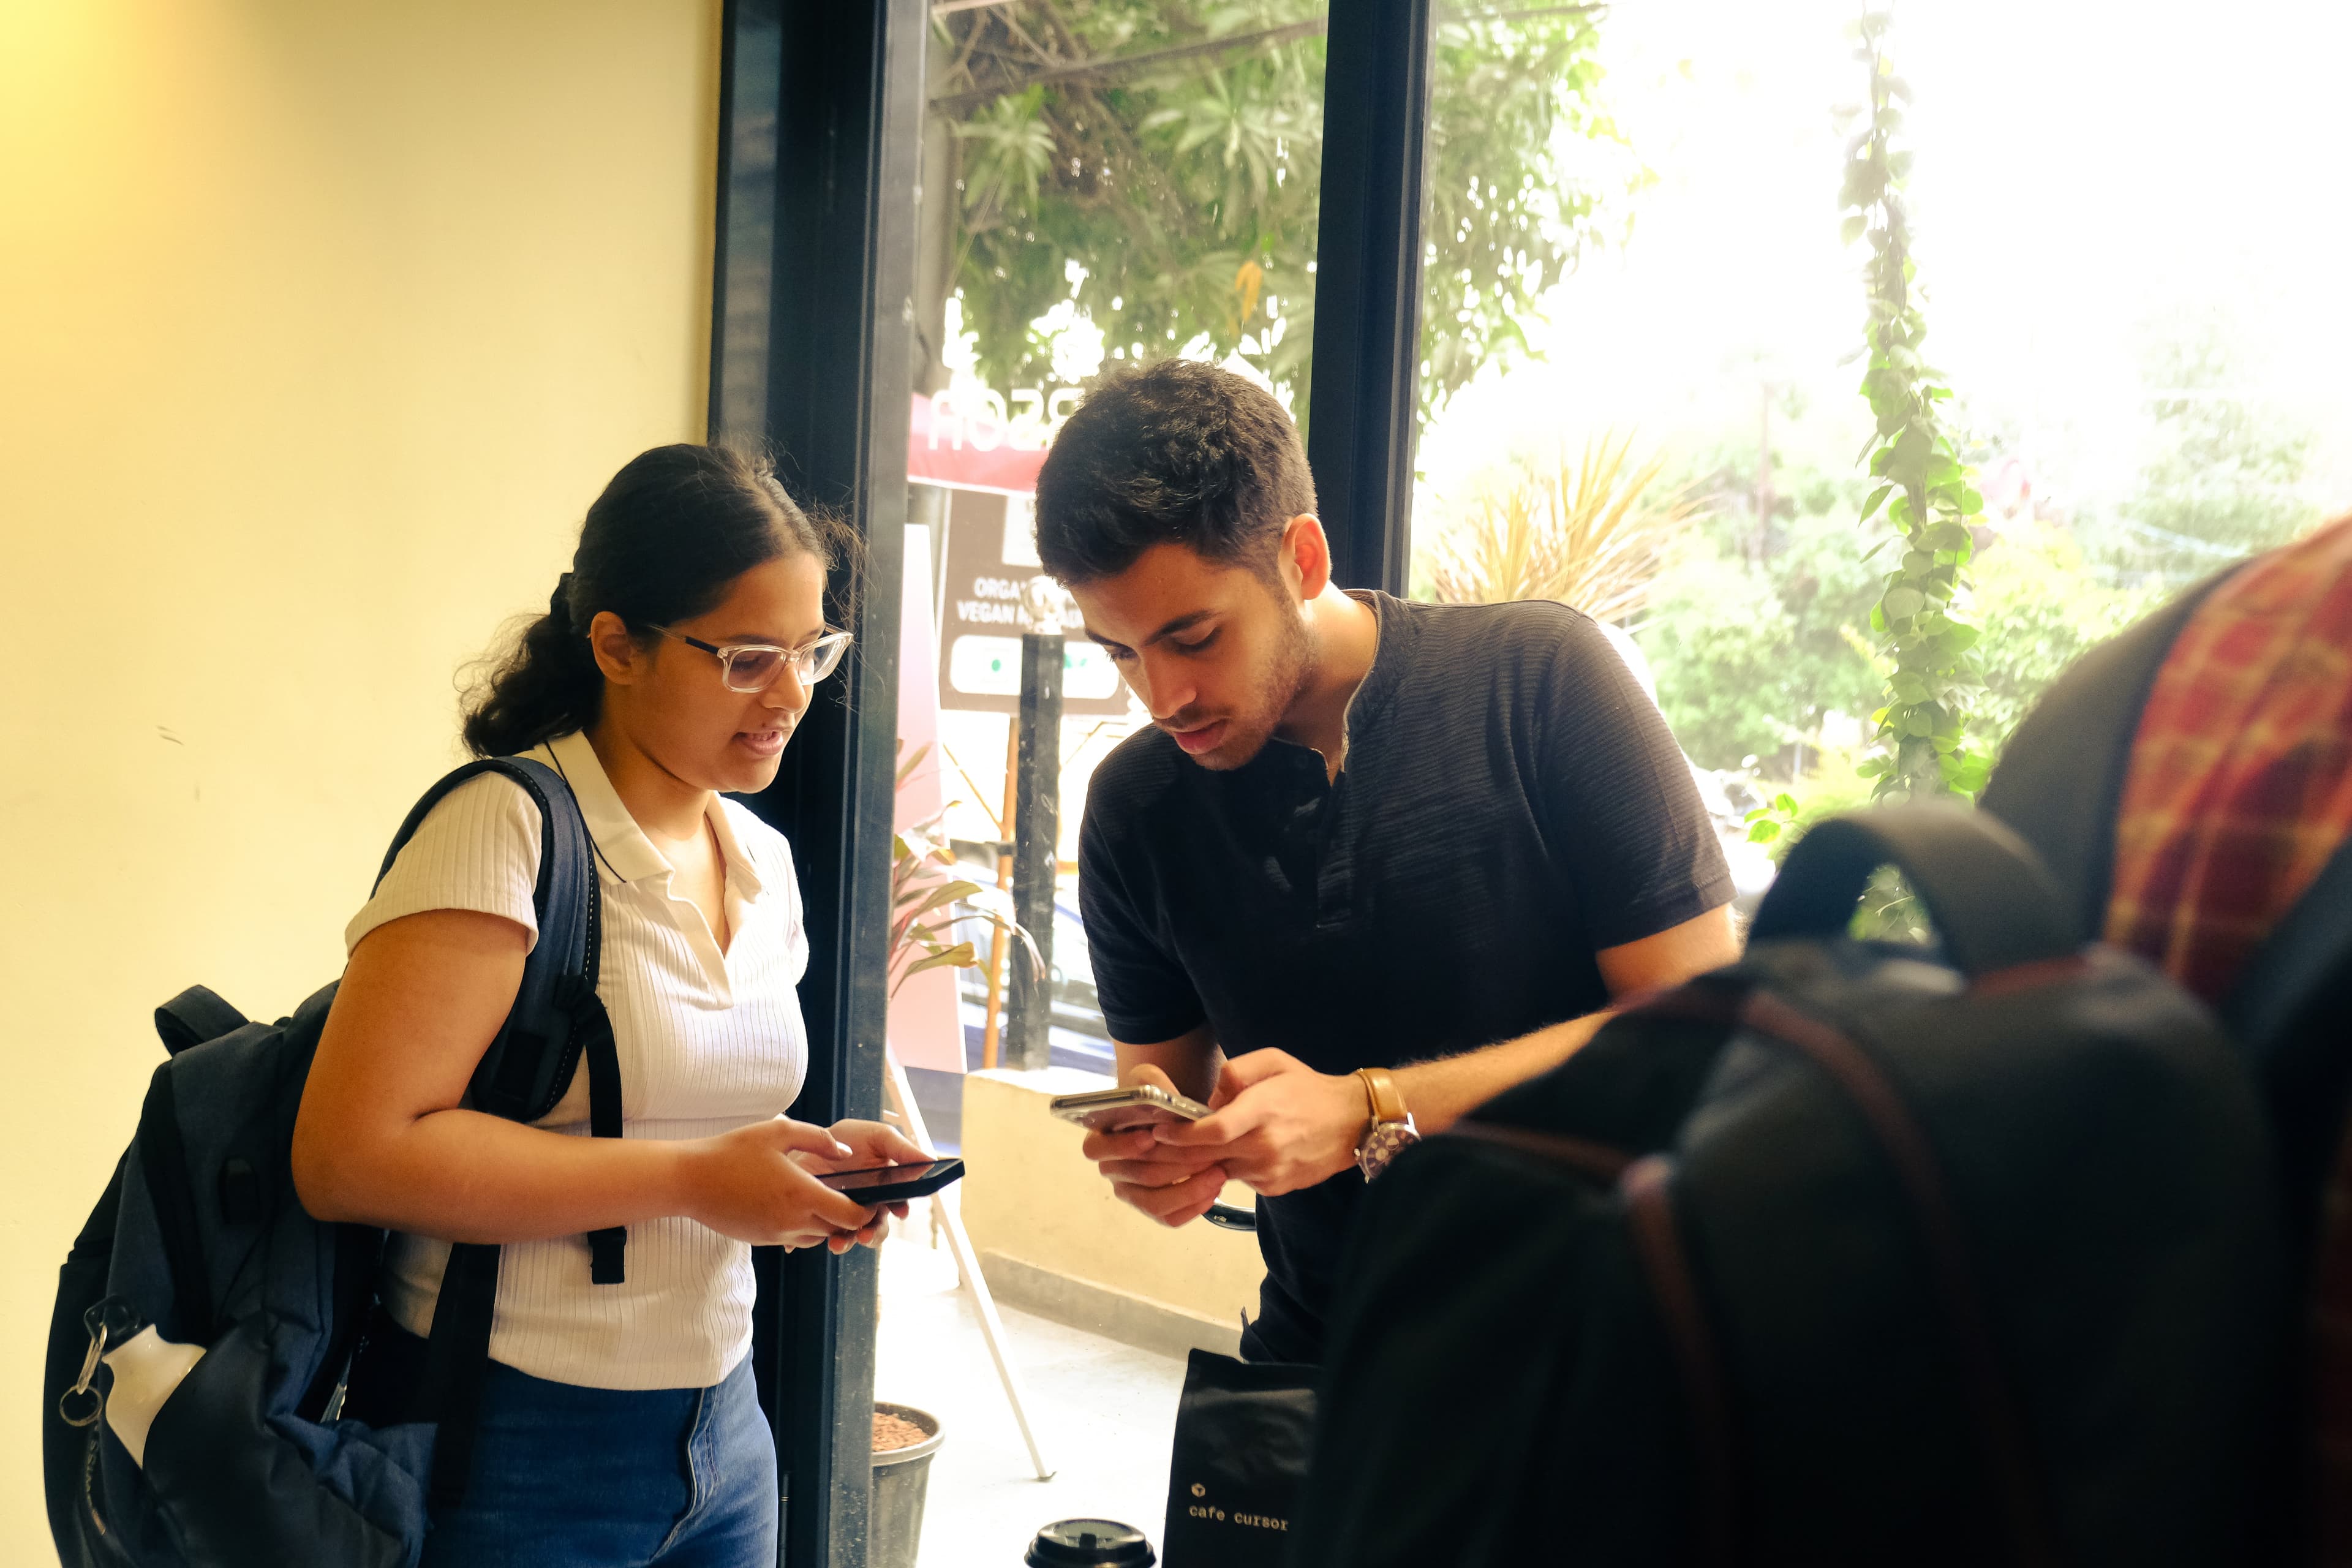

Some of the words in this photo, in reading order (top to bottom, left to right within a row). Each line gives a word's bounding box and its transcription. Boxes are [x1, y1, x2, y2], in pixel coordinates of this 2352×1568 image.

[974, 577, 1027, 600] ORGA
[957, 600, 1016, 624] VEGAN
[1189, 1505, 1226, 1521] cafe
[1234, 1512, 1289, 1531] cursor
